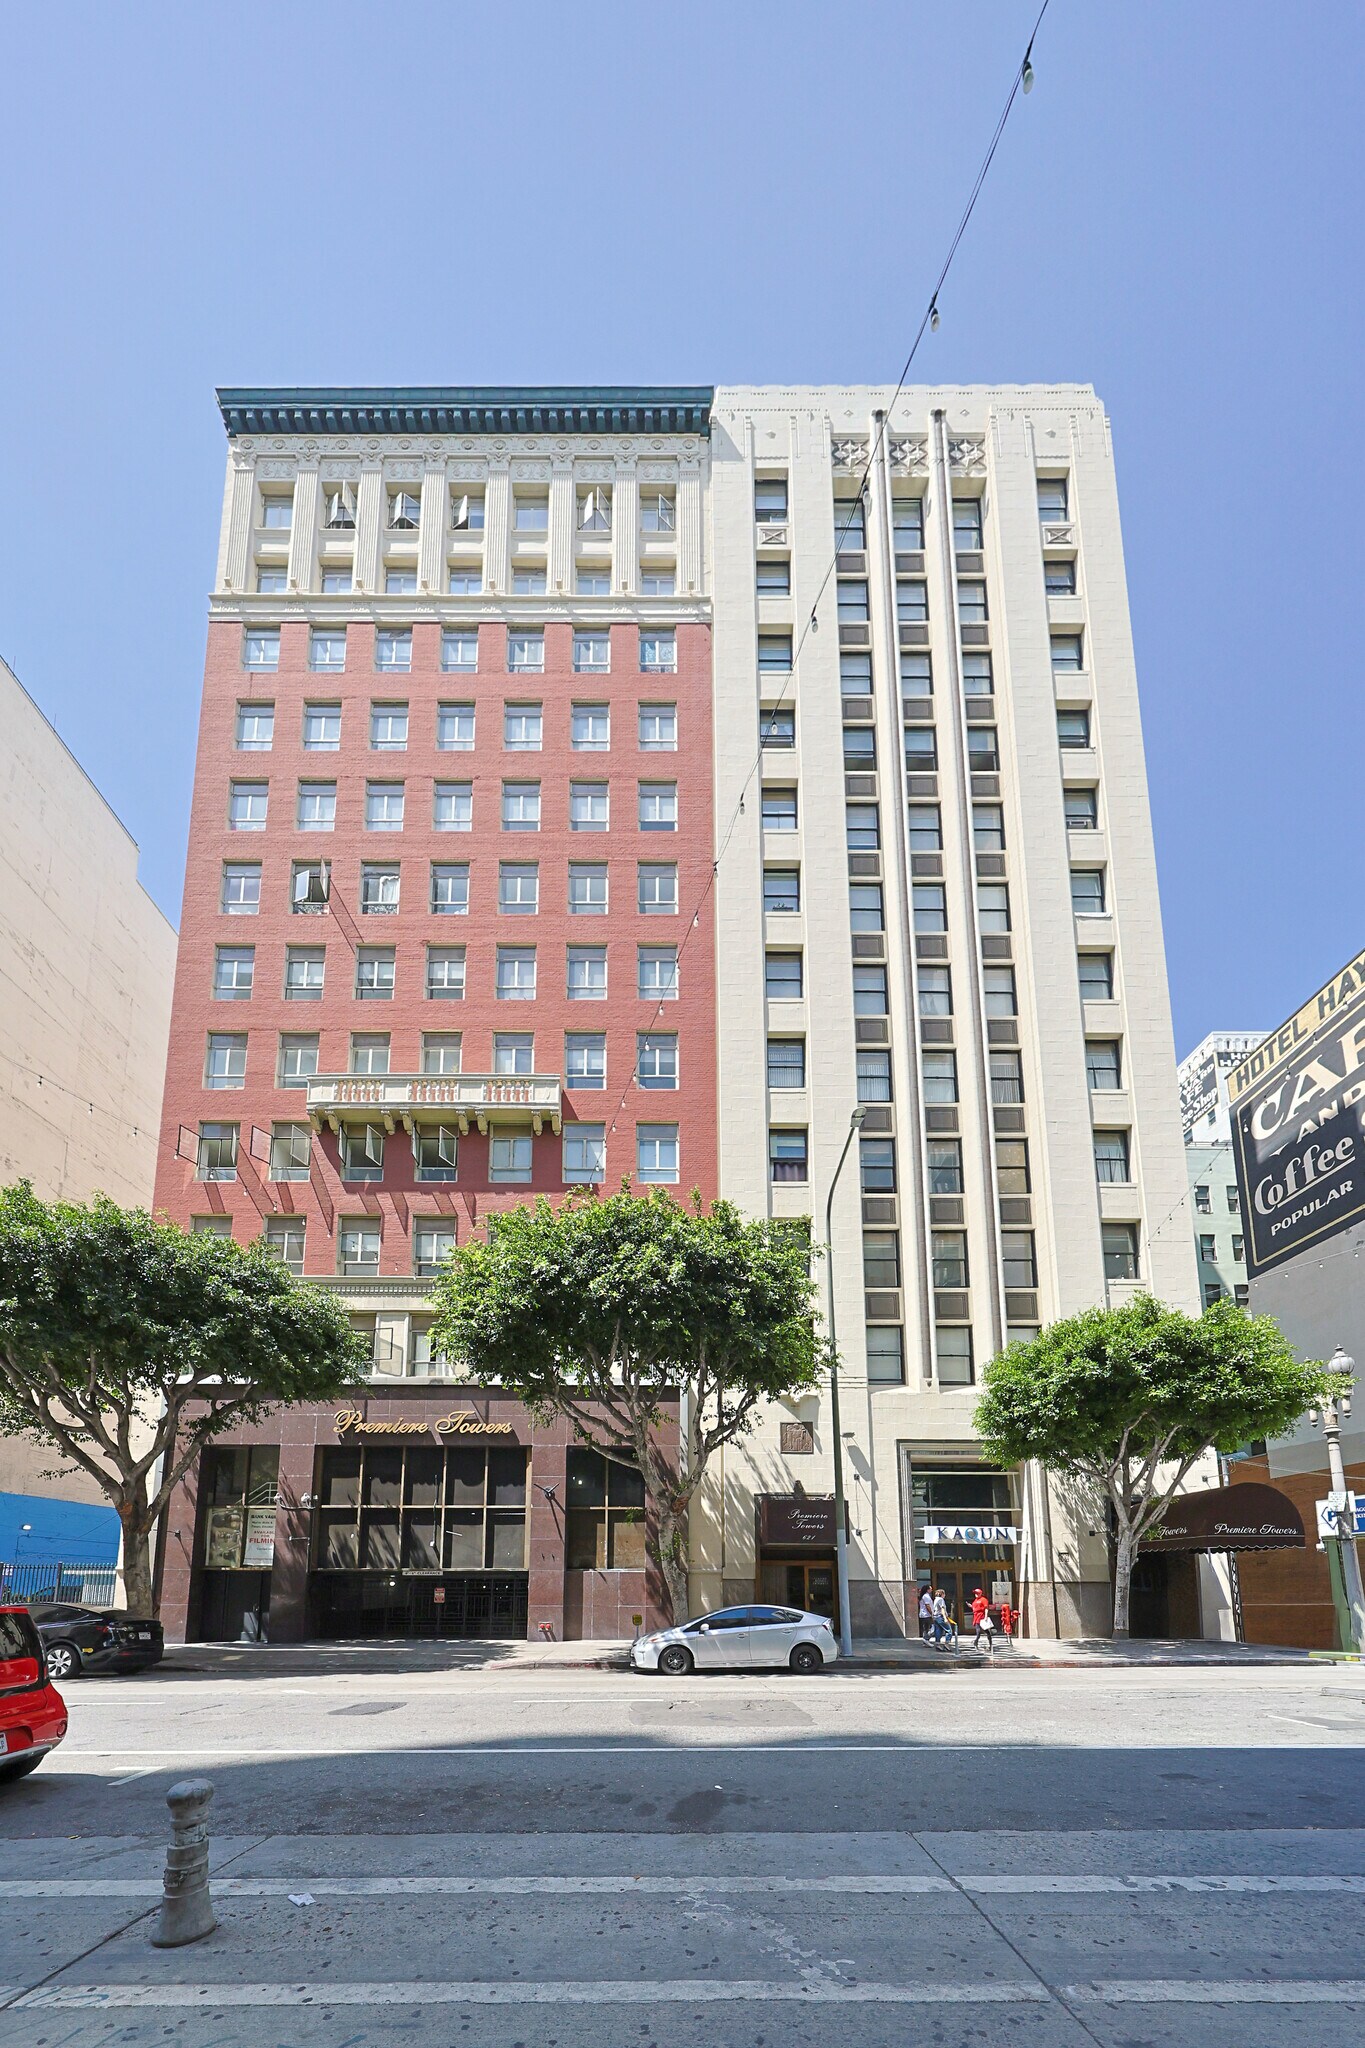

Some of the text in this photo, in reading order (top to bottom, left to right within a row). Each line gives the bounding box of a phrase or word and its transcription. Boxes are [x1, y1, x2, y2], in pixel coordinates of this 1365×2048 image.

[1236, 1018, 1308, 1092] HOTEL
[1297, 1080, 1365, 1143] AND
[1254, 1136, 1355, 1215] Coffee
[1271, 1180, 1354, 1237] POPULAR
[333, 1409, 513, 1435] Premiere Towers
[788, 1509, 828, 1519] Premiere
[792, 1519, 825, 1529] Towers
[937, 1526, 1009, 1544] KAQUN
[1158, 1523, 1299, 1537] Towers Premiere Towers
